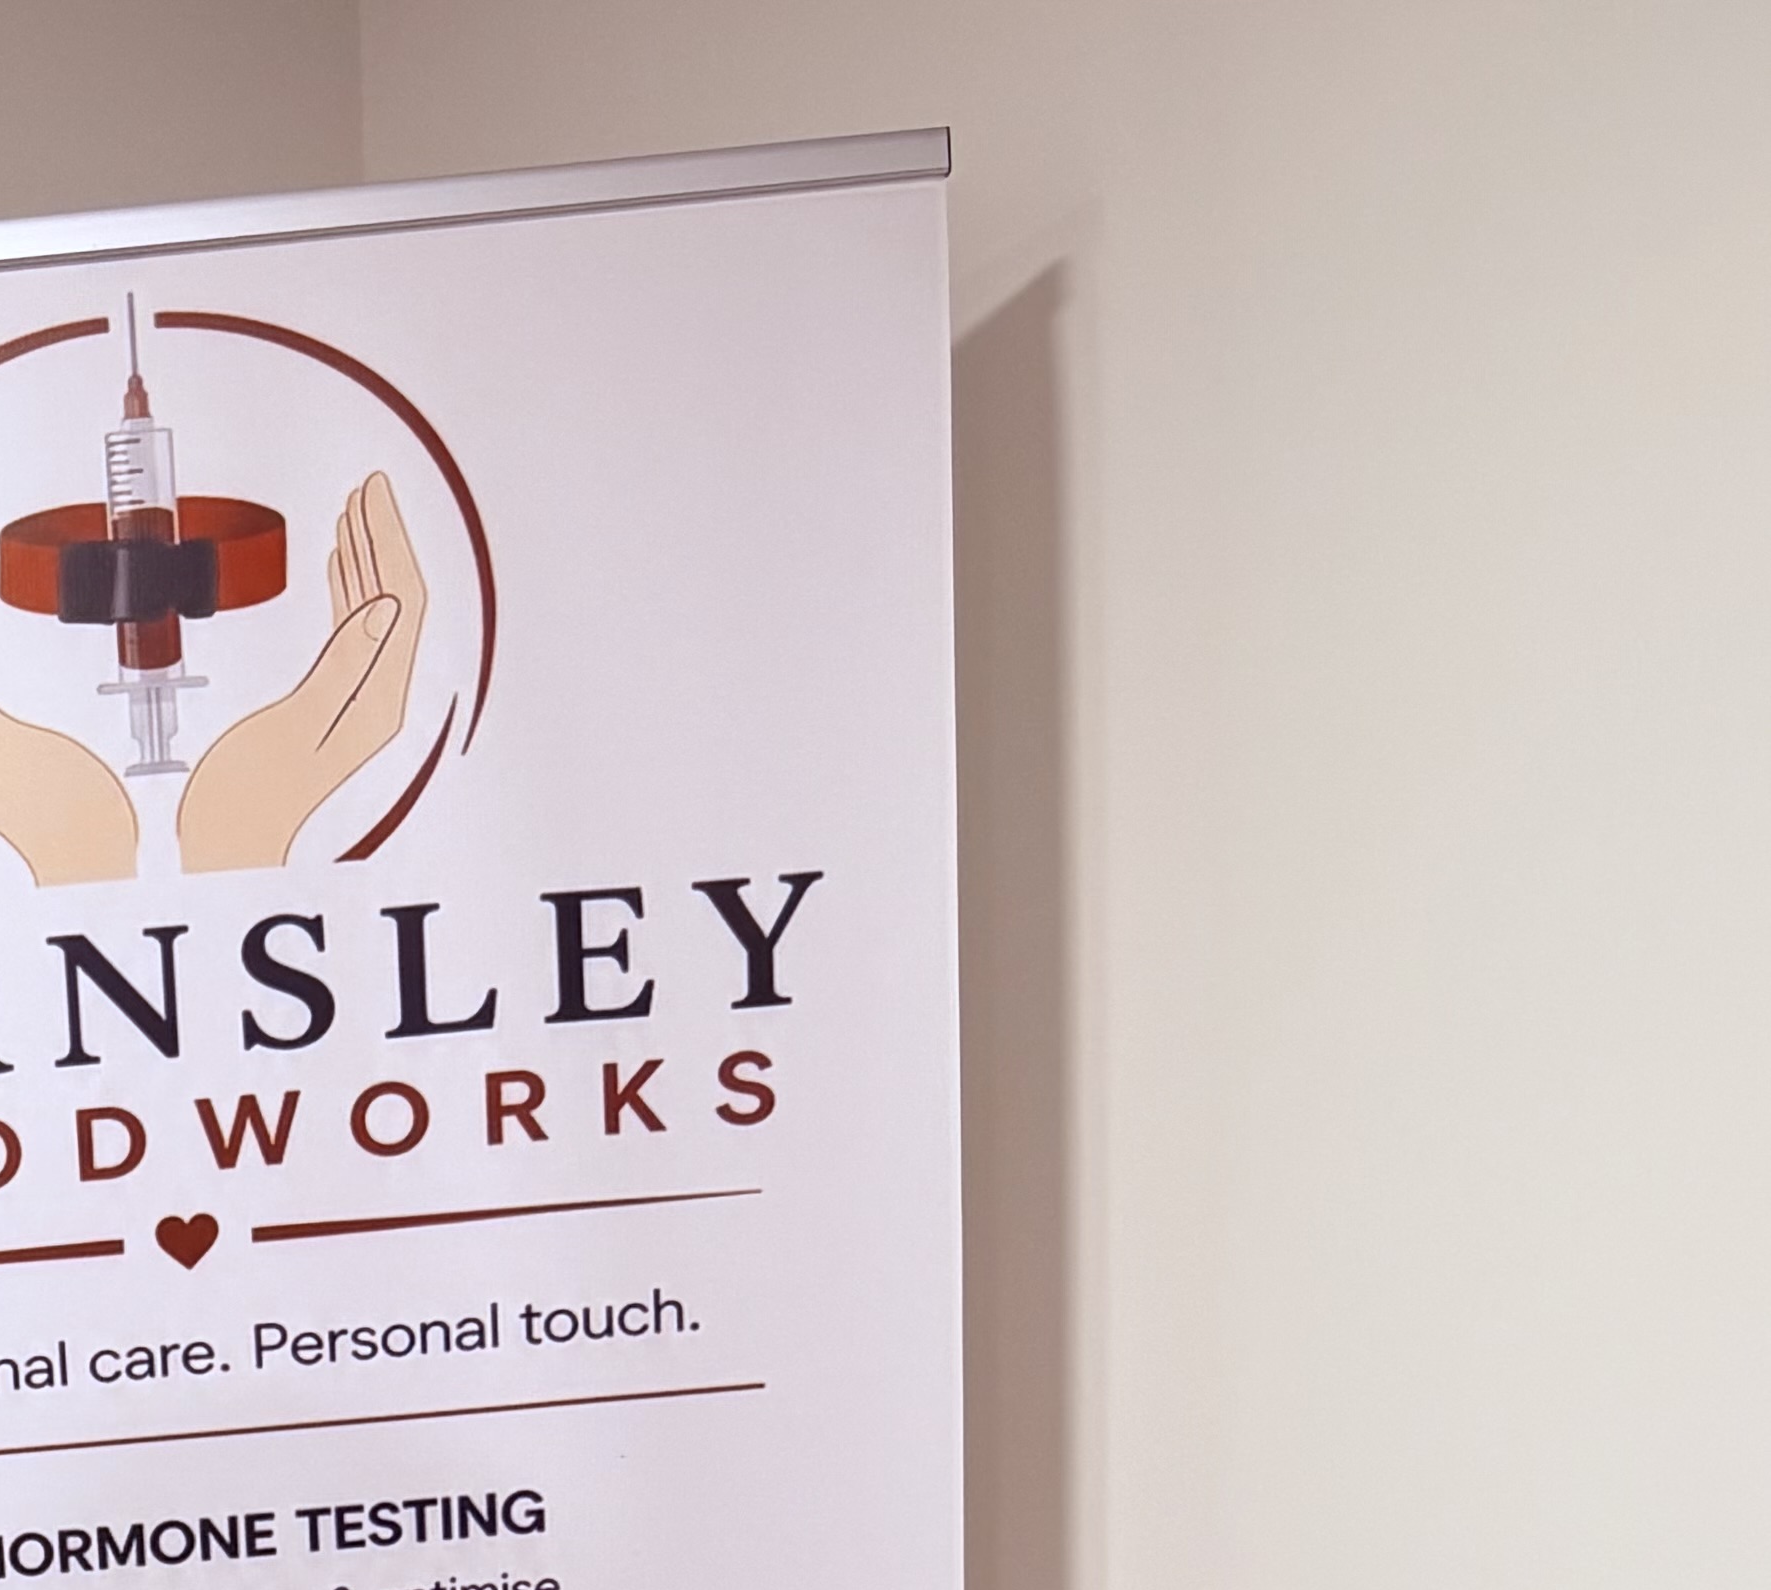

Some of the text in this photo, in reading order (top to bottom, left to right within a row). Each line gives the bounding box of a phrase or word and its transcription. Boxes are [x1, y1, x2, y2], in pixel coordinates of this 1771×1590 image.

[90, 1342, 230, 1383] care.
[254, 1303, 499, 1369] Personal
[519, 1289, 699, 1345] touch.
[295, 1490, 545, 1552] TESTING
